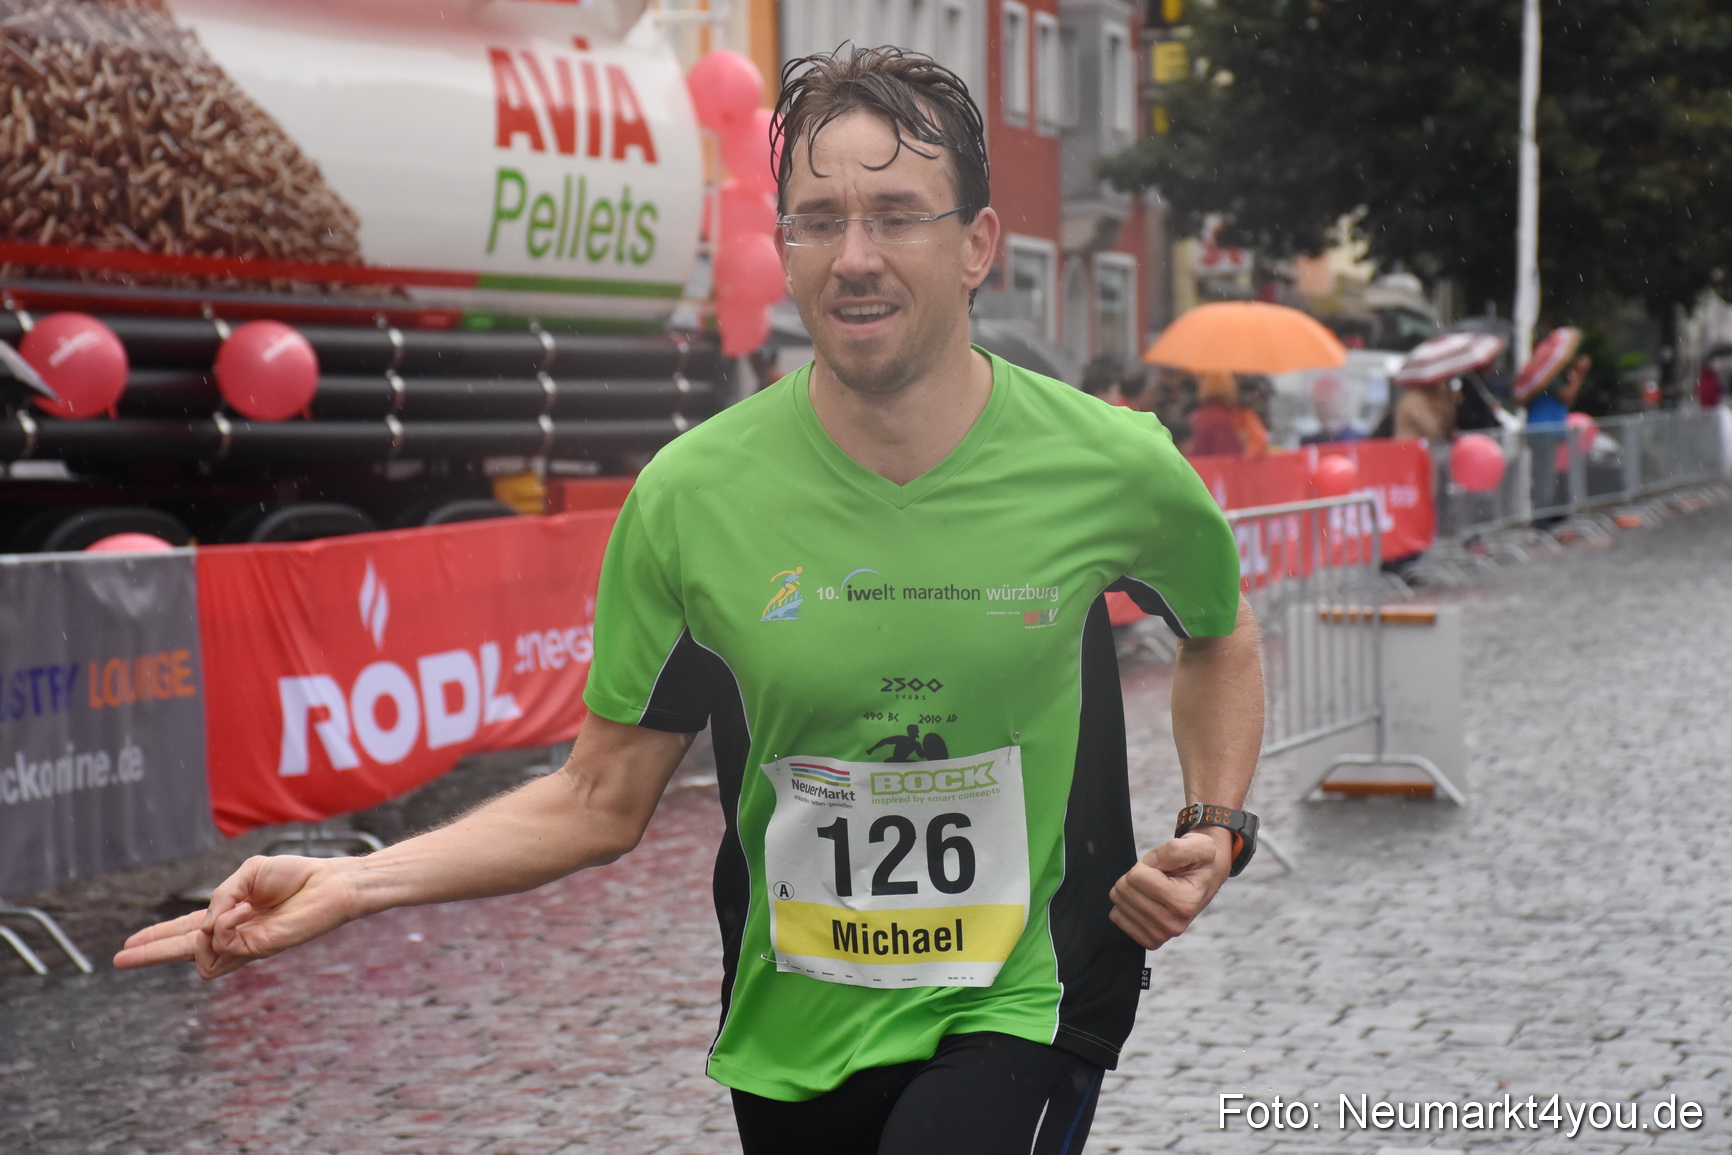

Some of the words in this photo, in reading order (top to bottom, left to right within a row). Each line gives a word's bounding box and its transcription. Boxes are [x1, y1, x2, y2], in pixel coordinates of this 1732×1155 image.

[485, 166, 660, 266] Pellets
[816, 586, 839, 601] 10.
[847, 583, 895, 601] iwelt
[903, 584, 981, 601] marathon
[986, 583, 1059, 602] würzburg
[880, 677, 944, 693] 2500
[863, 711, 884, 721] 490
[888, 712, 899, 722] BC
[918, 714, 942, 724] 2010
[870, 760, 999, 795] BOCK
[791, 778, 856, 801] NeuerMarkt
[871, 795, 911, 806] inspired
[913, 795, 924, 804] by
[927, 794, 956, 803] smart
[958, 788, 1001, 800] concepts
[817, 812, 976, 897] 126
[779, 884, 790, 898] A
[831, 919, 963, 955] Michael
